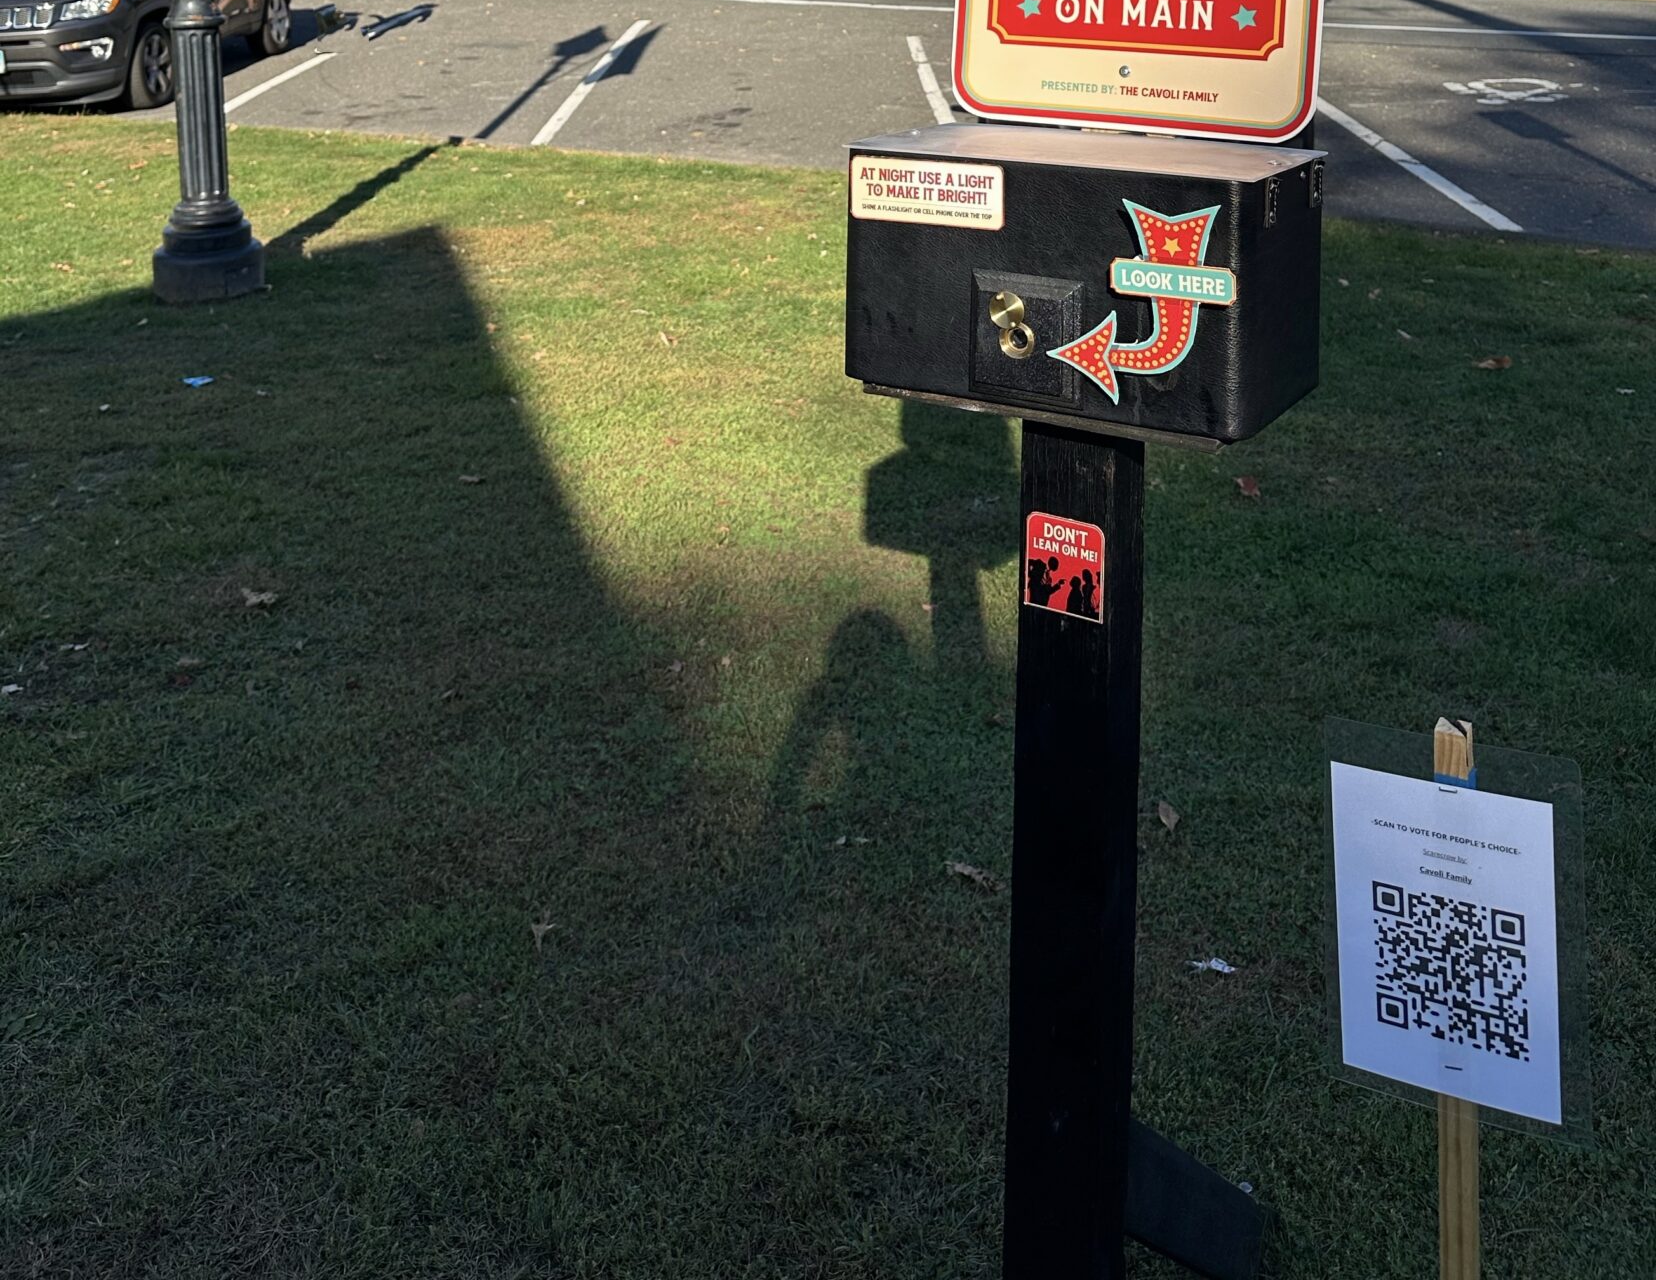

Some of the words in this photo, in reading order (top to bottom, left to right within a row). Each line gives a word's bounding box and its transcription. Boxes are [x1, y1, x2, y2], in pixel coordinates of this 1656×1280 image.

[1041, 80, 1098, 93] PRESENTED
[1100, 84, 1118, 95] BY:
[1119, 85, 1139, 97] THE
[1141, 87, 1180, 100] CAVOLI
[1182, 90, 1219, 103] FAMILY
[860, 167, 876, 180] AT
[879, 168, 915, 183] NIGHT
[919, 171, 942, 185] USE
[945, 173, 955, 187] A
[958, 174, 995, 190] LIGHT
[866, 183, 883, 197] TO
[886, 185, 920, 200] MAKE
[923, 188, 934, 201] IT
[938, 189, 987, 205] BRIGHT!
[862, 203, 877, 211] SHINE
[882, 205, 912, 213] FLASHLIGHT
[1121, 268, 1173, 291] LOOK
[1178, 274, 1226, 297] HERE
[1043, 522, 1088, 547] DON'T
[1033, 537, 1059, 553] LEAN
[1062, 544, 1078, 558] ON
[1080, 548, 1098, 563] ME!
[1396, 823, 1407, 832] TO
[1410, 826, 1430, 837] VOTE
[1432, 831, 1447, 841] FOR
[1449, 835, 1486, 849] PEOPLE'S
[1422, 848, 1456, 862] Scarecrow
[1420, 866, 1444, 879] Cavoli
[1445, 871, 1472, 885] Family
